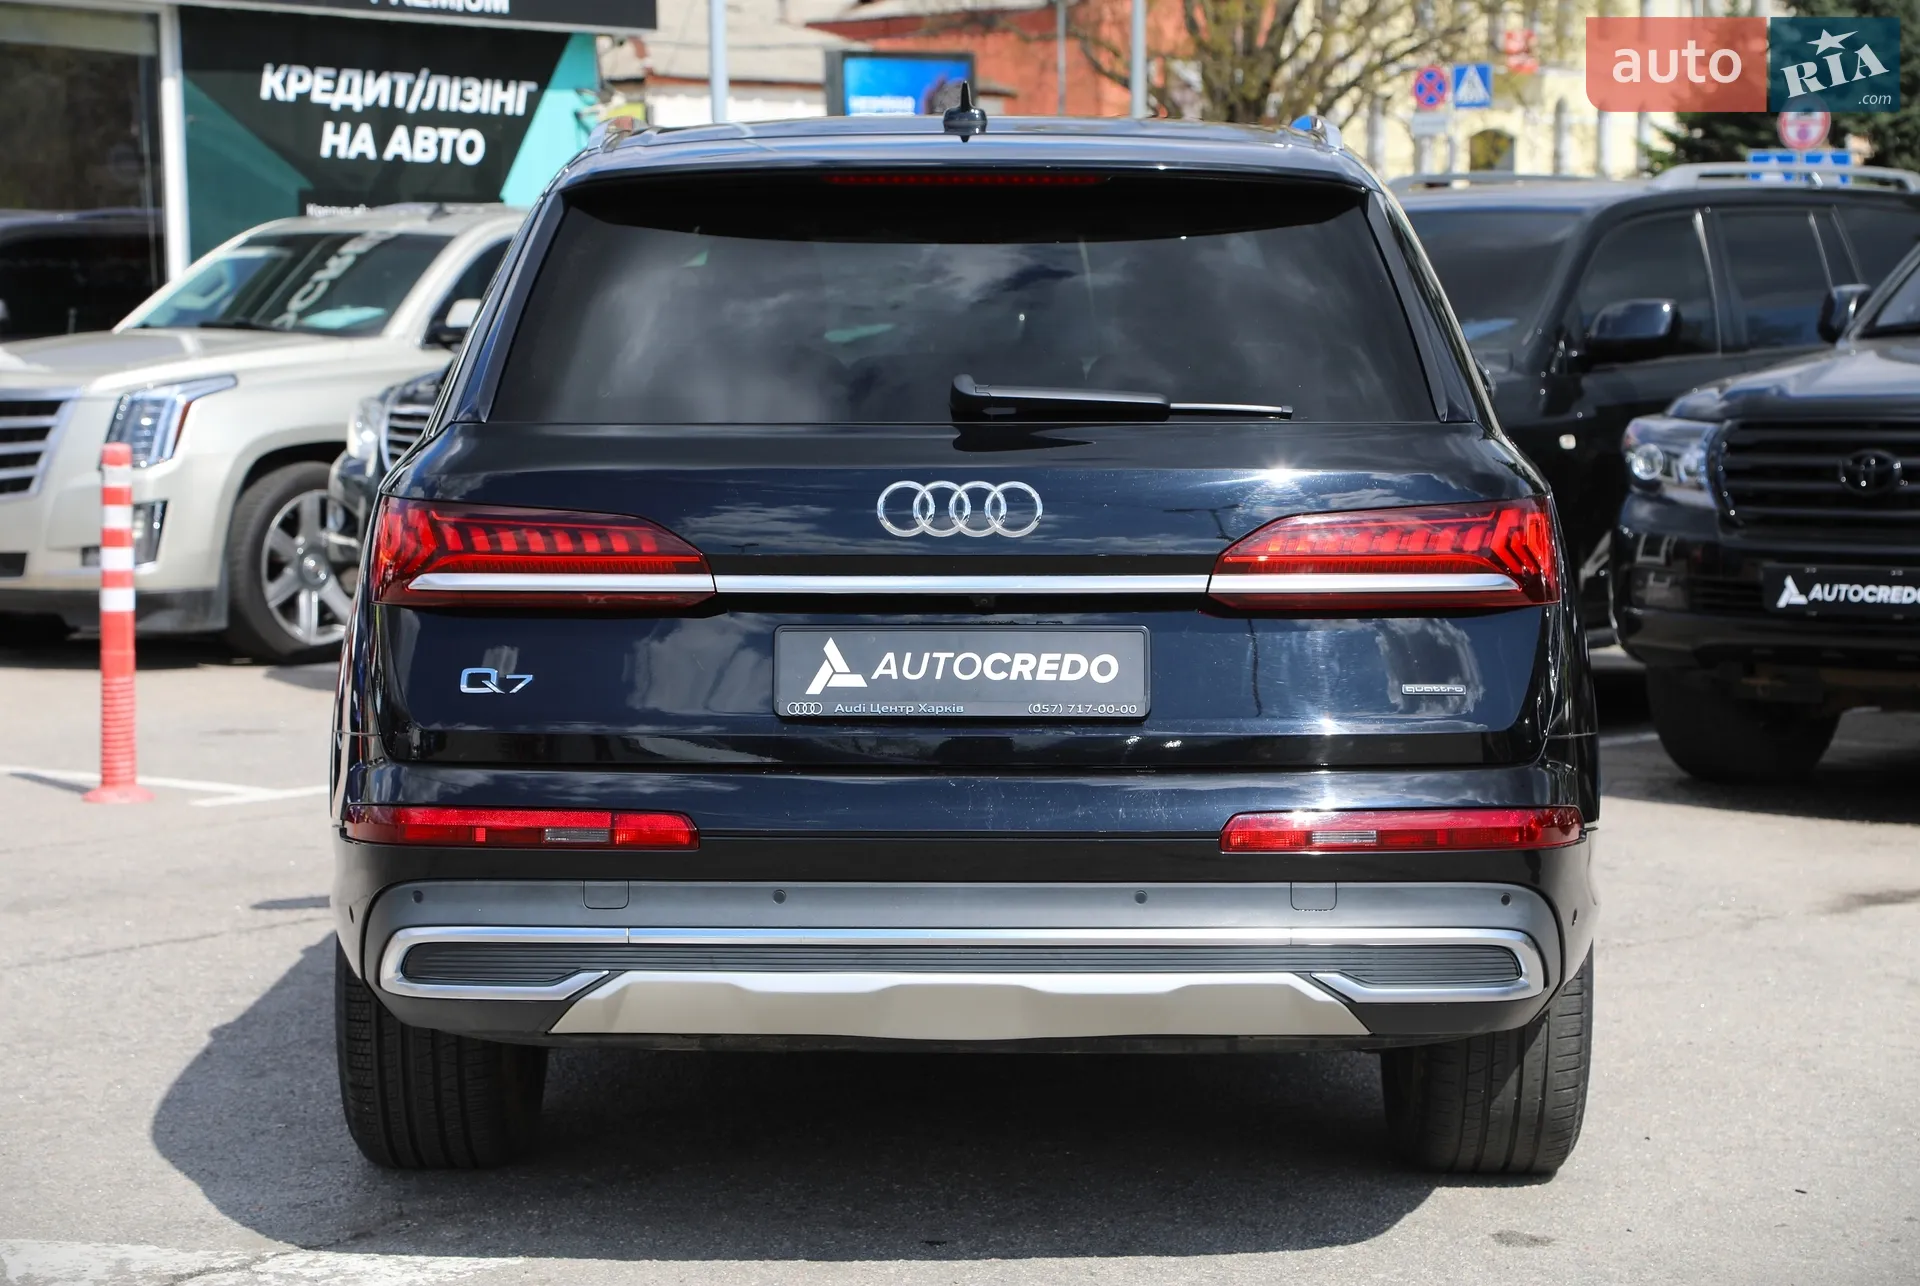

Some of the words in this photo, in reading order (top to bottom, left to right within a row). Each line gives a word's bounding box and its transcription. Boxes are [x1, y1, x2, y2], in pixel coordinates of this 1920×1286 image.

[259, 63, 538, 116] КРЕДИТ/ЛІЗІНГ
[320, 121, 377, 160] НА
[383, 125, 486, 166] АВТО
[1808, 583, 1920, 605] AUTOCRED
[460, 667, 533, 694] Q7
[871, 652, 1119, 684] AUTOCREDO
[834, 703, 866, 713] Audi
[870, 704, 914, 715] Центр
[918, 703, 964, 715] Харків
[1028, 704, 1063, 714] (057)
[1067, 704, 1137, 714] 717-00-00
